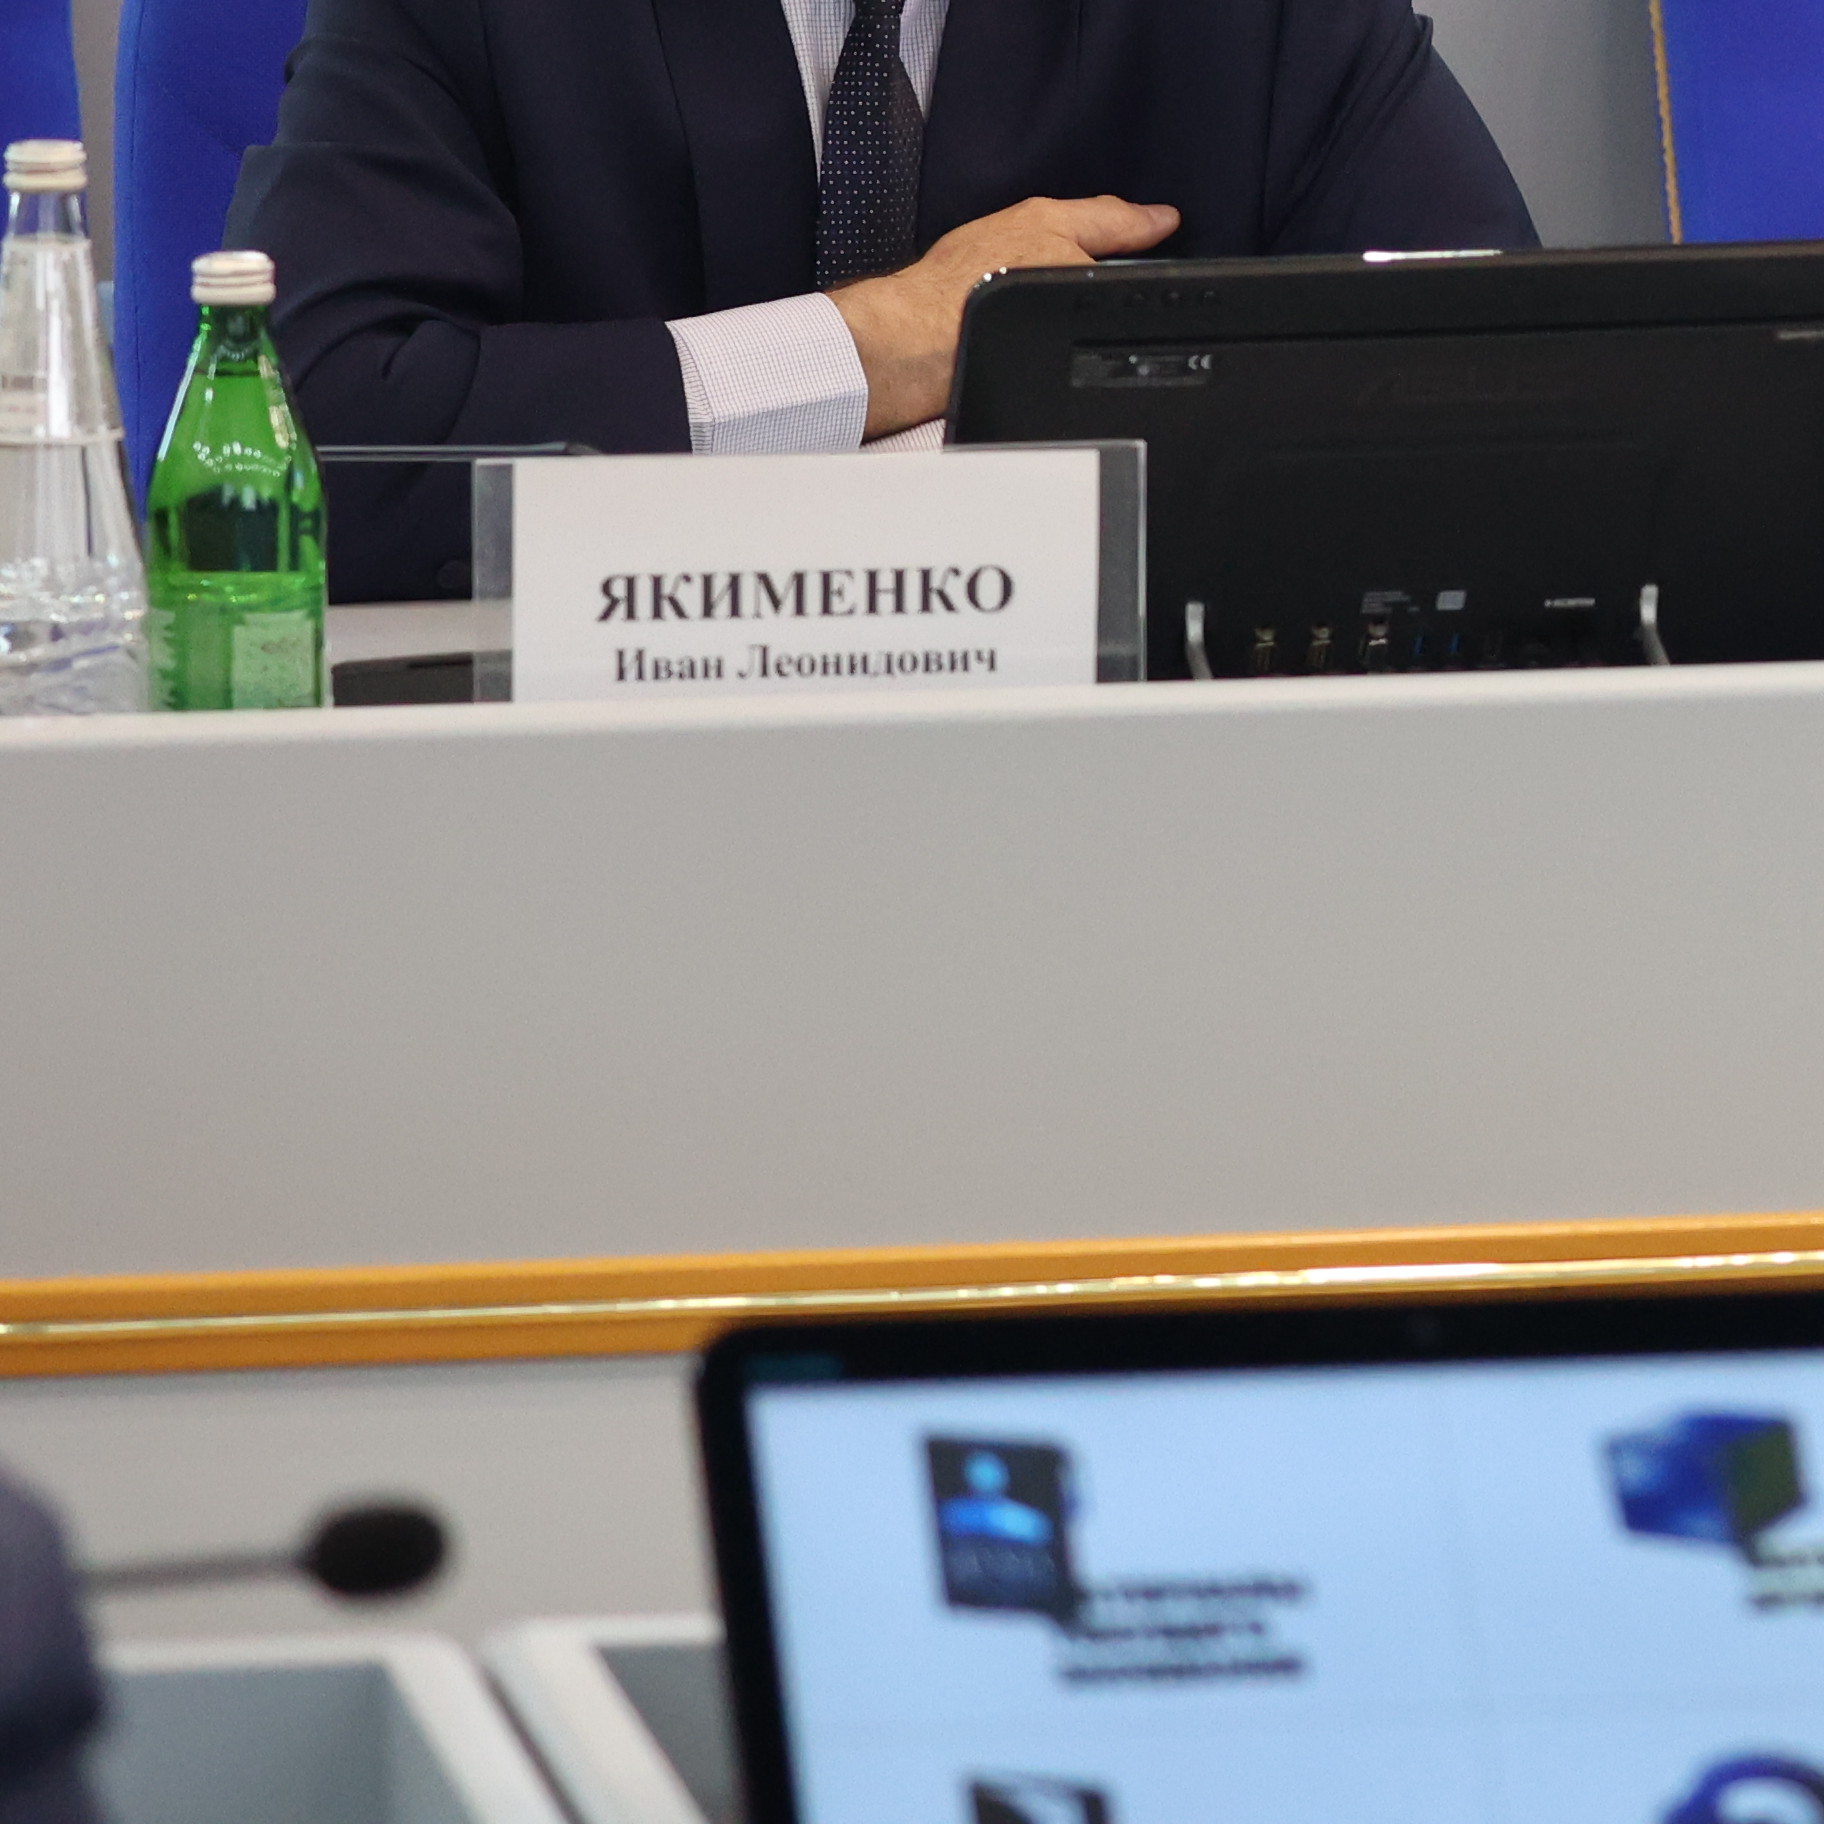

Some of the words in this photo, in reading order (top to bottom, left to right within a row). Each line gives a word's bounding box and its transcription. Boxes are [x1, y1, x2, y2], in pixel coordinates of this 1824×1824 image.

[597, 566, 1016, 624] ЯКИМЕНКО
[615, 649, 725, 684] Иван
[738, 645, 998, 681] Леонидович
